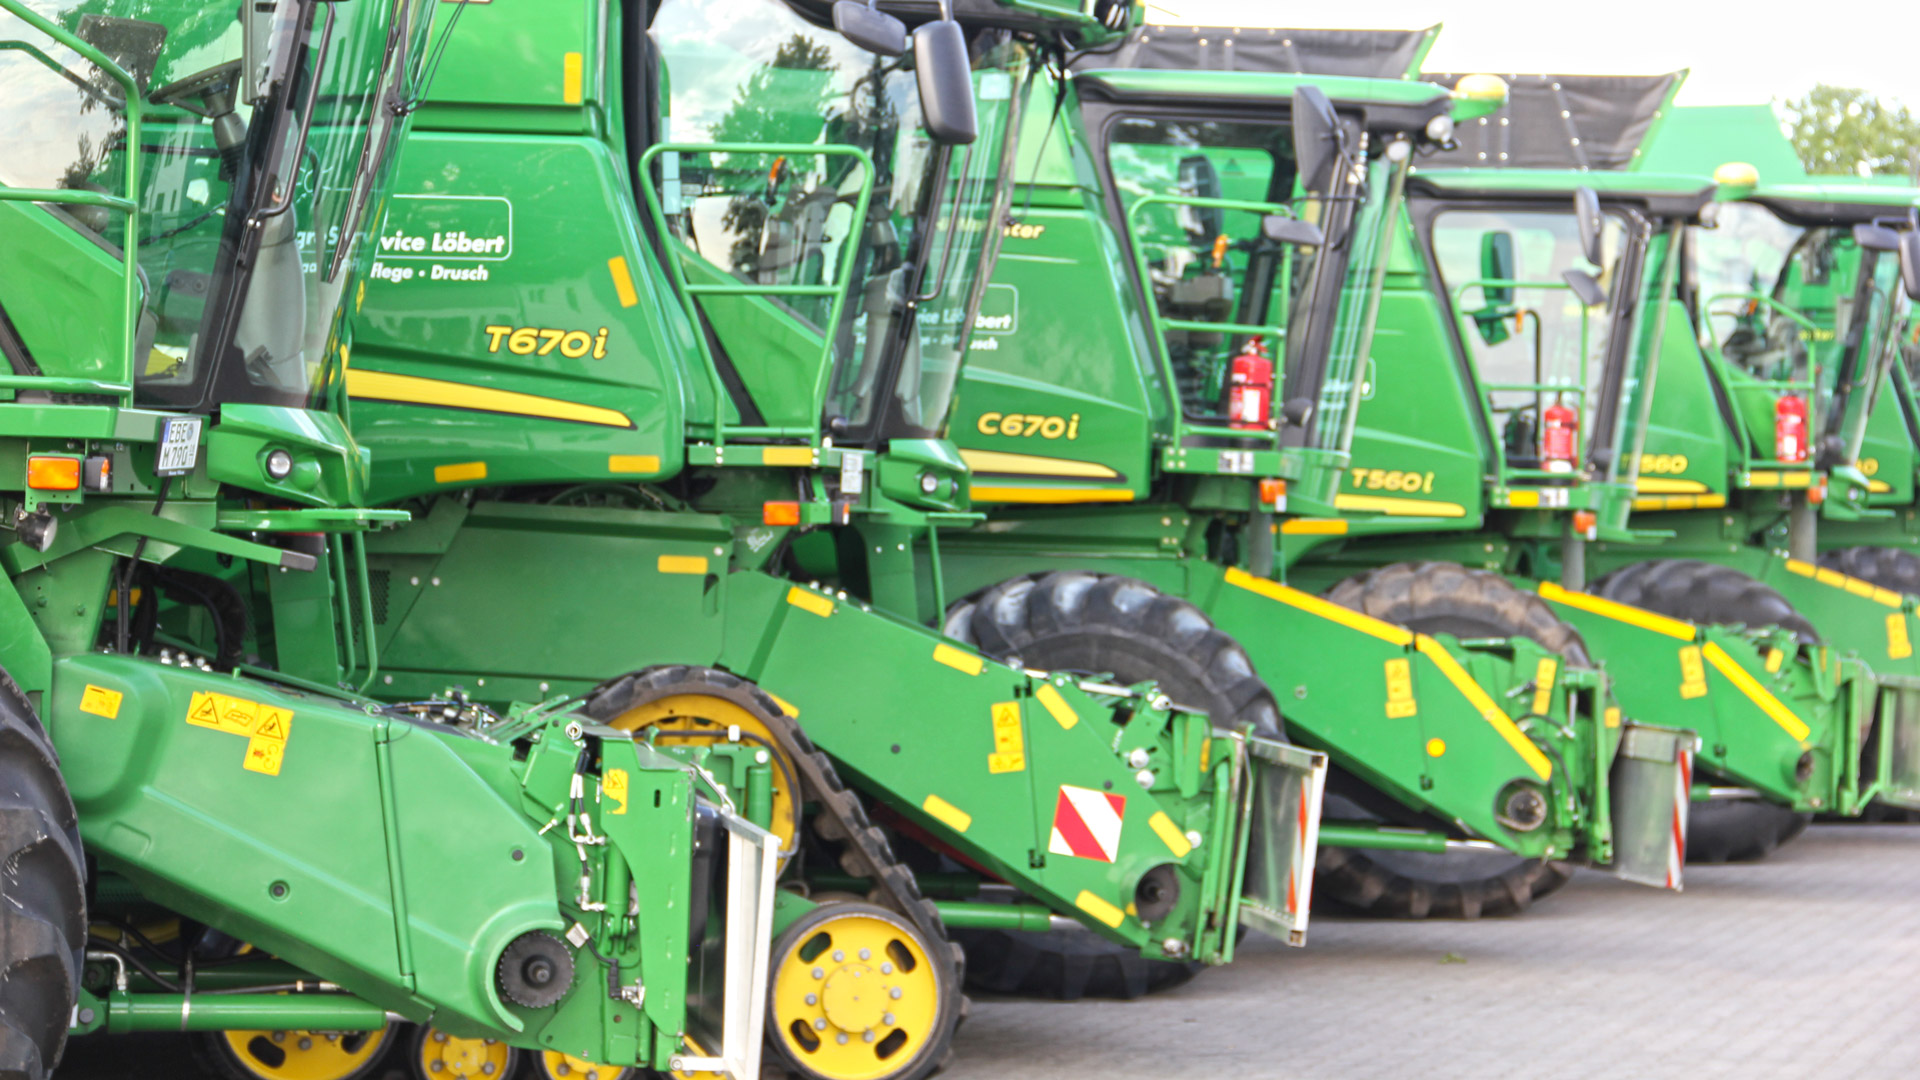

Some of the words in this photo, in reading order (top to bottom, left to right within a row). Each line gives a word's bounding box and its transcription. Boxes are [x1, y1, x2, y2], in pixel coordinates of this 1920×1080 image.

[432, 232, 505, 253] Löbert
[431, 265, 489, 280] Drusch
[485, 326, 609, 360] T670i
[169, 423, 188, 443] EBE
[977, 411, 1080, 441] C670i
[1351, 467, 1435, 495] T560i
